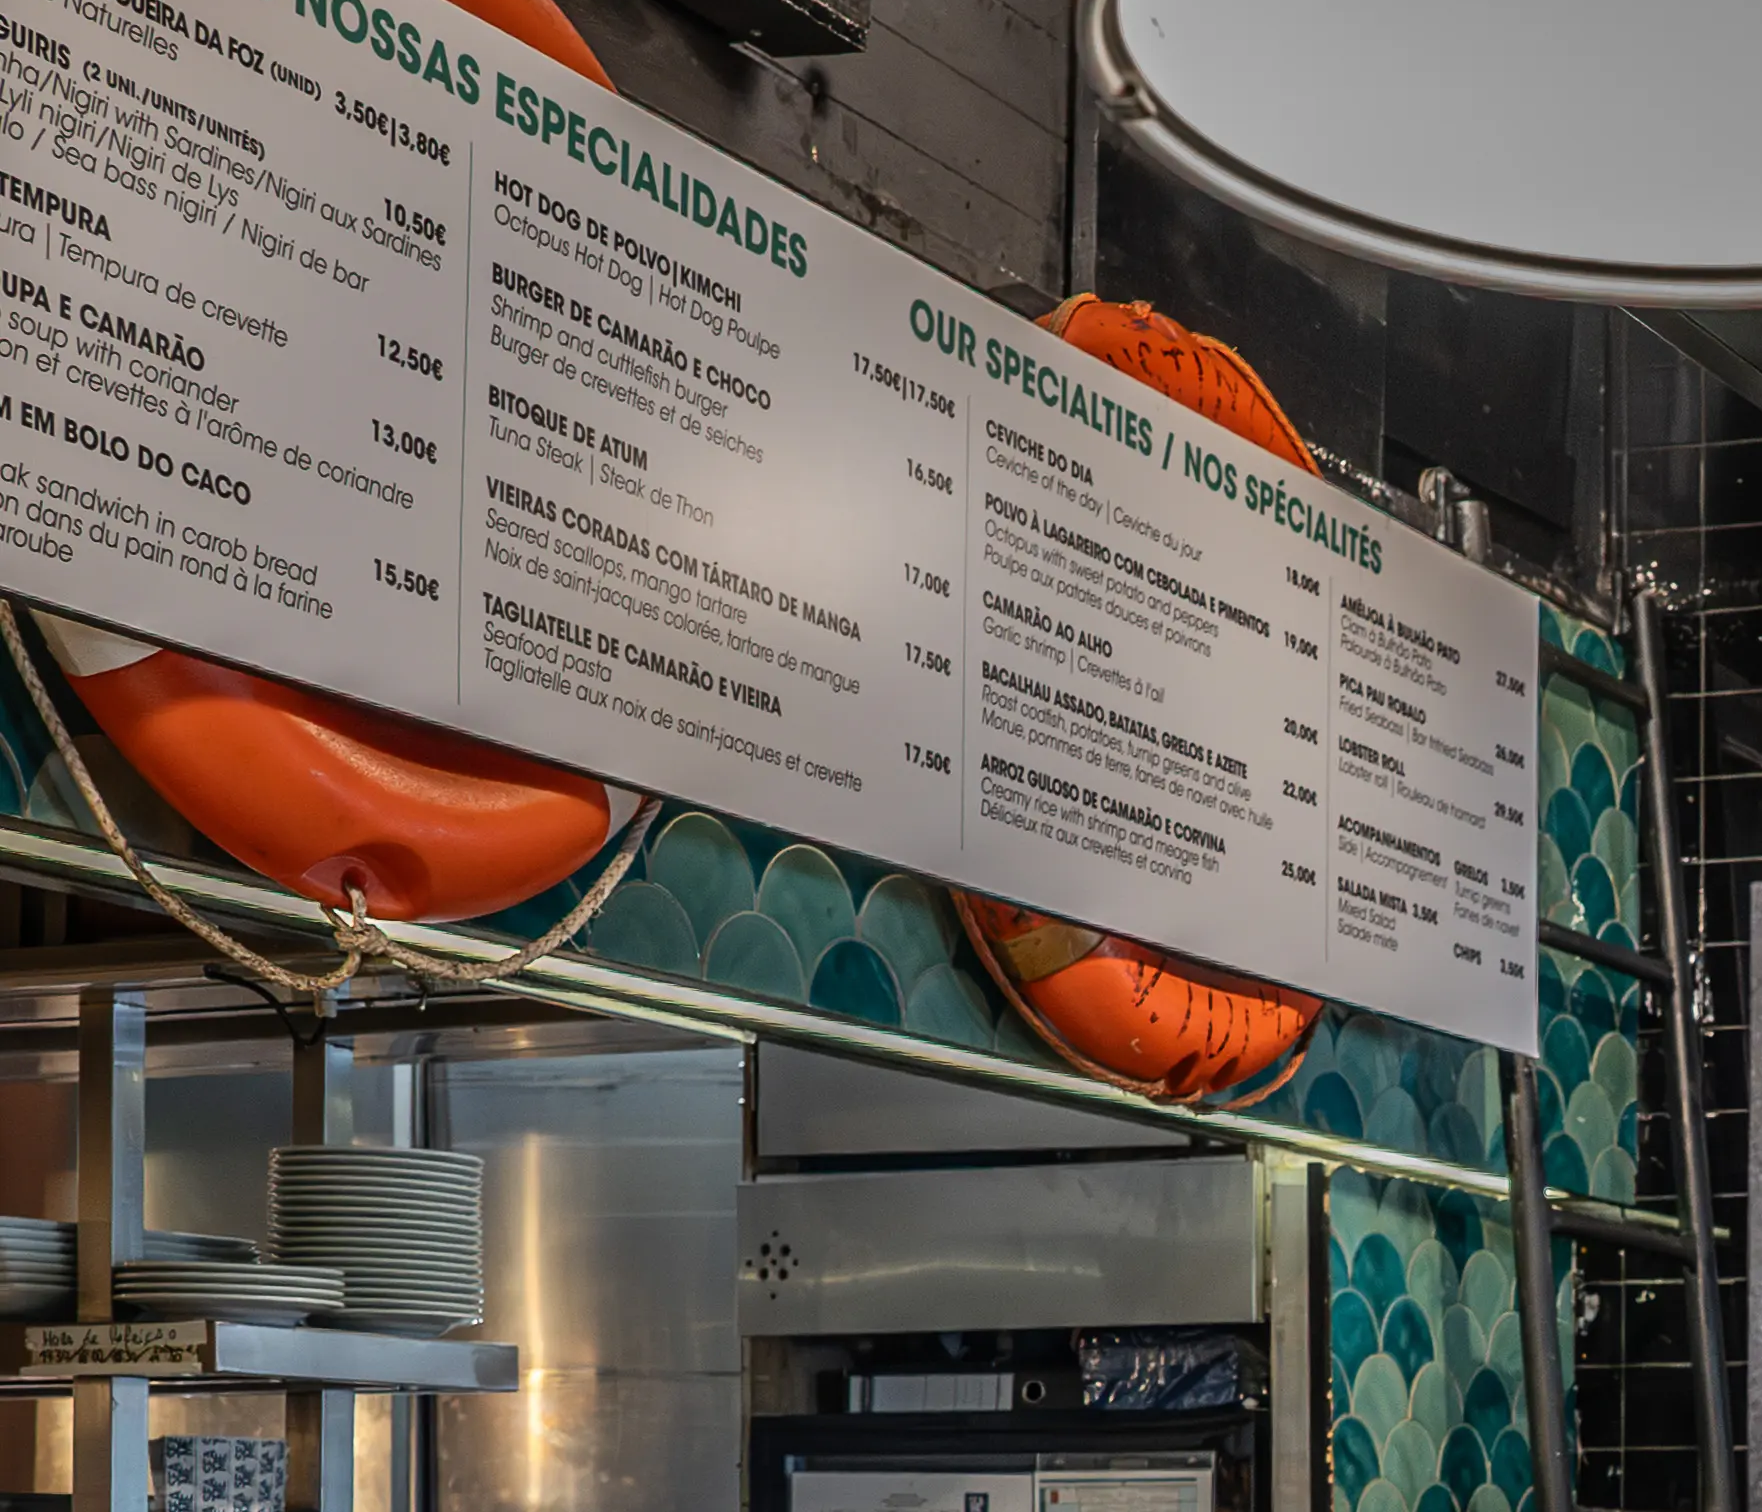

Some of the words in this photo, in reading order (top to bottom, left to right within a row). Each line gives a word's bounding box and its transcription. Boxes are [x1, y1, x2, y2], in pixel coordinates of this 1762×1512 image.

[82, 60, 101, 83] (2
[194, 19, 224, 56] DA
[227, 36, 265, 76] FOZ
[270, 60, 322, 102] (UNID)
[114, 106, 159, 142] with
[320, 202, 359, 234] aux
[361, 216, 442, 272] Sardines
[384, 197, 447, 247] 10,50€
[494, 170, 534, 208] HOT
[538, 192, 582, 231] DOG
[586, 217, 609, 247] DE
[495, 71, 808, 279] ESPECIALIDADES
[59, 293, 72, 321] E
[79, 303, 205, 372] CAMARÃO
[494, 203, 570, 257] Octopus
[574, 241, 605, 273] Hot
[607, 258, 643, 298] Dog
[658, 283, 687, 314] Hot
[689, 299, 724, 337] Dog
[726, 317, 781, 360] Poulpe
[7, 311, 69, 351] soup
[76, 336, 122, 371] with
[129, 359, 240, 414] coriander
[377, 333, 444, 382] 12,50€
[490, 293, 553, 341] Shrimp
[557, 329, 595, 358] and
[597, 348, 671, 394] cuttlefish
[674, 378, 729, 419] burger
[491, 261, 565, 316] BURGER
[569, 299, 593, 329] DE
[597, 313, 688, 372] CAMARÃO
[693, 357, 702, 380] E
[706, 364, 771, 411] CHOCO
[20, 401, 55, 437] EM
[63, 417, 130, 462] BOLO
[137, 443, 174, 478] DO
[181, 461, 252, 506] CACO
[35, 352, 61, 376] et
[66, 364, 169, 418] crevettes
[174, 400, 191, 427] à
[196, 408, 278, 458] l'arôme
[282, 445, 312, 471] de
[317, 460, 414, 510] coriandre
[371, 418, 438, 465] 13,00€
[488, 383, 568, 437] BITOQUE
[573, 420, 596, 449] DE
[599, 433, 648, 472] ATUM
[488, 414, 532, 452] Tuna
[535, 436, 584, 474] Steak
[599, 462, 646, 499] Steak
[649, 487, 673, 510] de
[676, 493, 714, 527] Thon
[906, 457, 953, 496] 16,50€
[909, 298, 977, 368] OUR
[985, 337, 1153, 457] SPECIALTIES
[1183, 440, 1238, 501] NOS
[1244, 485, 1383, 575] SPÉCIALITÉS
[35, 475, 149, 530] sandwich
[155, 510, 176, 539] in
[182, 526, 248, 562] carob
[253, 544, 318, 587] bread
[373, 557, 440, 602] 15,50€
[485, 507, 550, 550] Seared
[553, 538, 627, 581] scallops,
[630, 568, 692, 605] mango
[696, 589, 748, 625] tartare
[486, 475, 557, 523] VIEIRAS
[562, 507, 650, 560] CORADAS
[655, 544, 698, 579] COM
[701, 561, 774, 607] TÁRTARO
[778, 591, 798, 618] DE
[802, 601, 862, 642] MANGA
[904, 562, 950, 599] 17,00€
[482, 591, 592, 650] TAGLIATELLE
[597, 632, 620, 660] DE
[624, 643, 714, 692] CAMARÃO
[718, 675, 728, 698] E
[730, 679, 782, 718] VIEIRA
[905, 641, 952, 677] 17,50€
[904, 741, 952, 776] 17,50€
